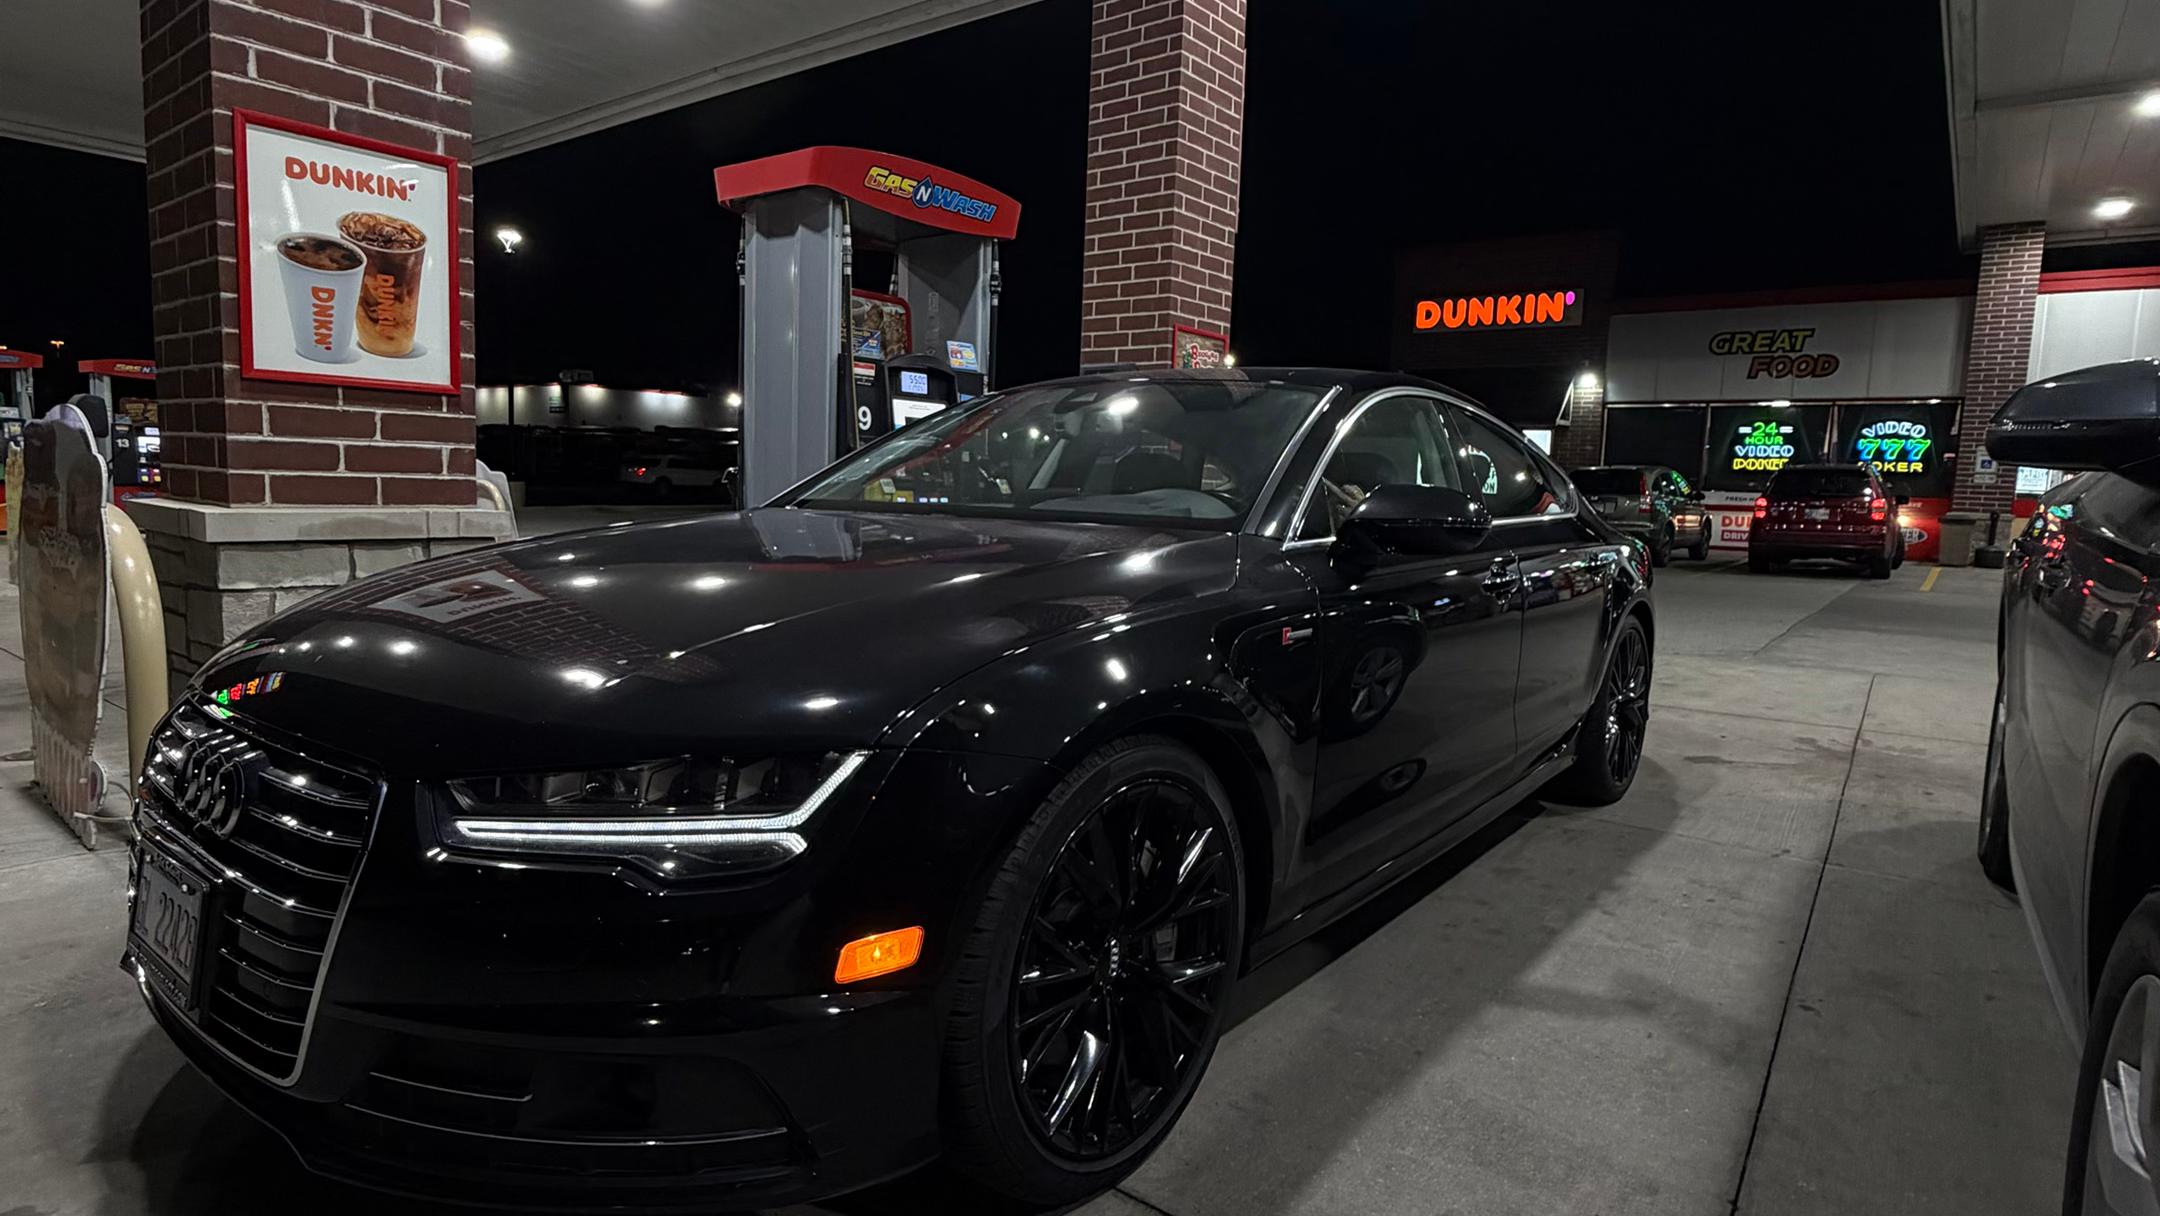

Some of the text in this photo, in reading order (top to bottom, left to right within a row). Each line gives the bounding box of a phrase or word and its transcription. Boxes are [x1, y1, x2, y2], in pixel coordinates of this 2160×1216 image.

[285, 156, 416, 201] DUNKIN'
[864, 165, 918, 199] GAS
[932, 184, 998, 223] WASH
[1415, 291, 1576, 330] DUNKIN'
[1709, 328, 1816, 356] GREAT
[1747, 353, 1840, 380] FOOD
[857, 405, 872, 431] 9
[1752, 421, 1779, 437] 24
[1861, 421, 1927, 438] VIDEO
[116, 438, 130, 448] 13
[1734, 445, 1795, 458] VIDEO
[1744, 435, 1784, 445] HOUR
[1856, 438, 1931, 461] 777
